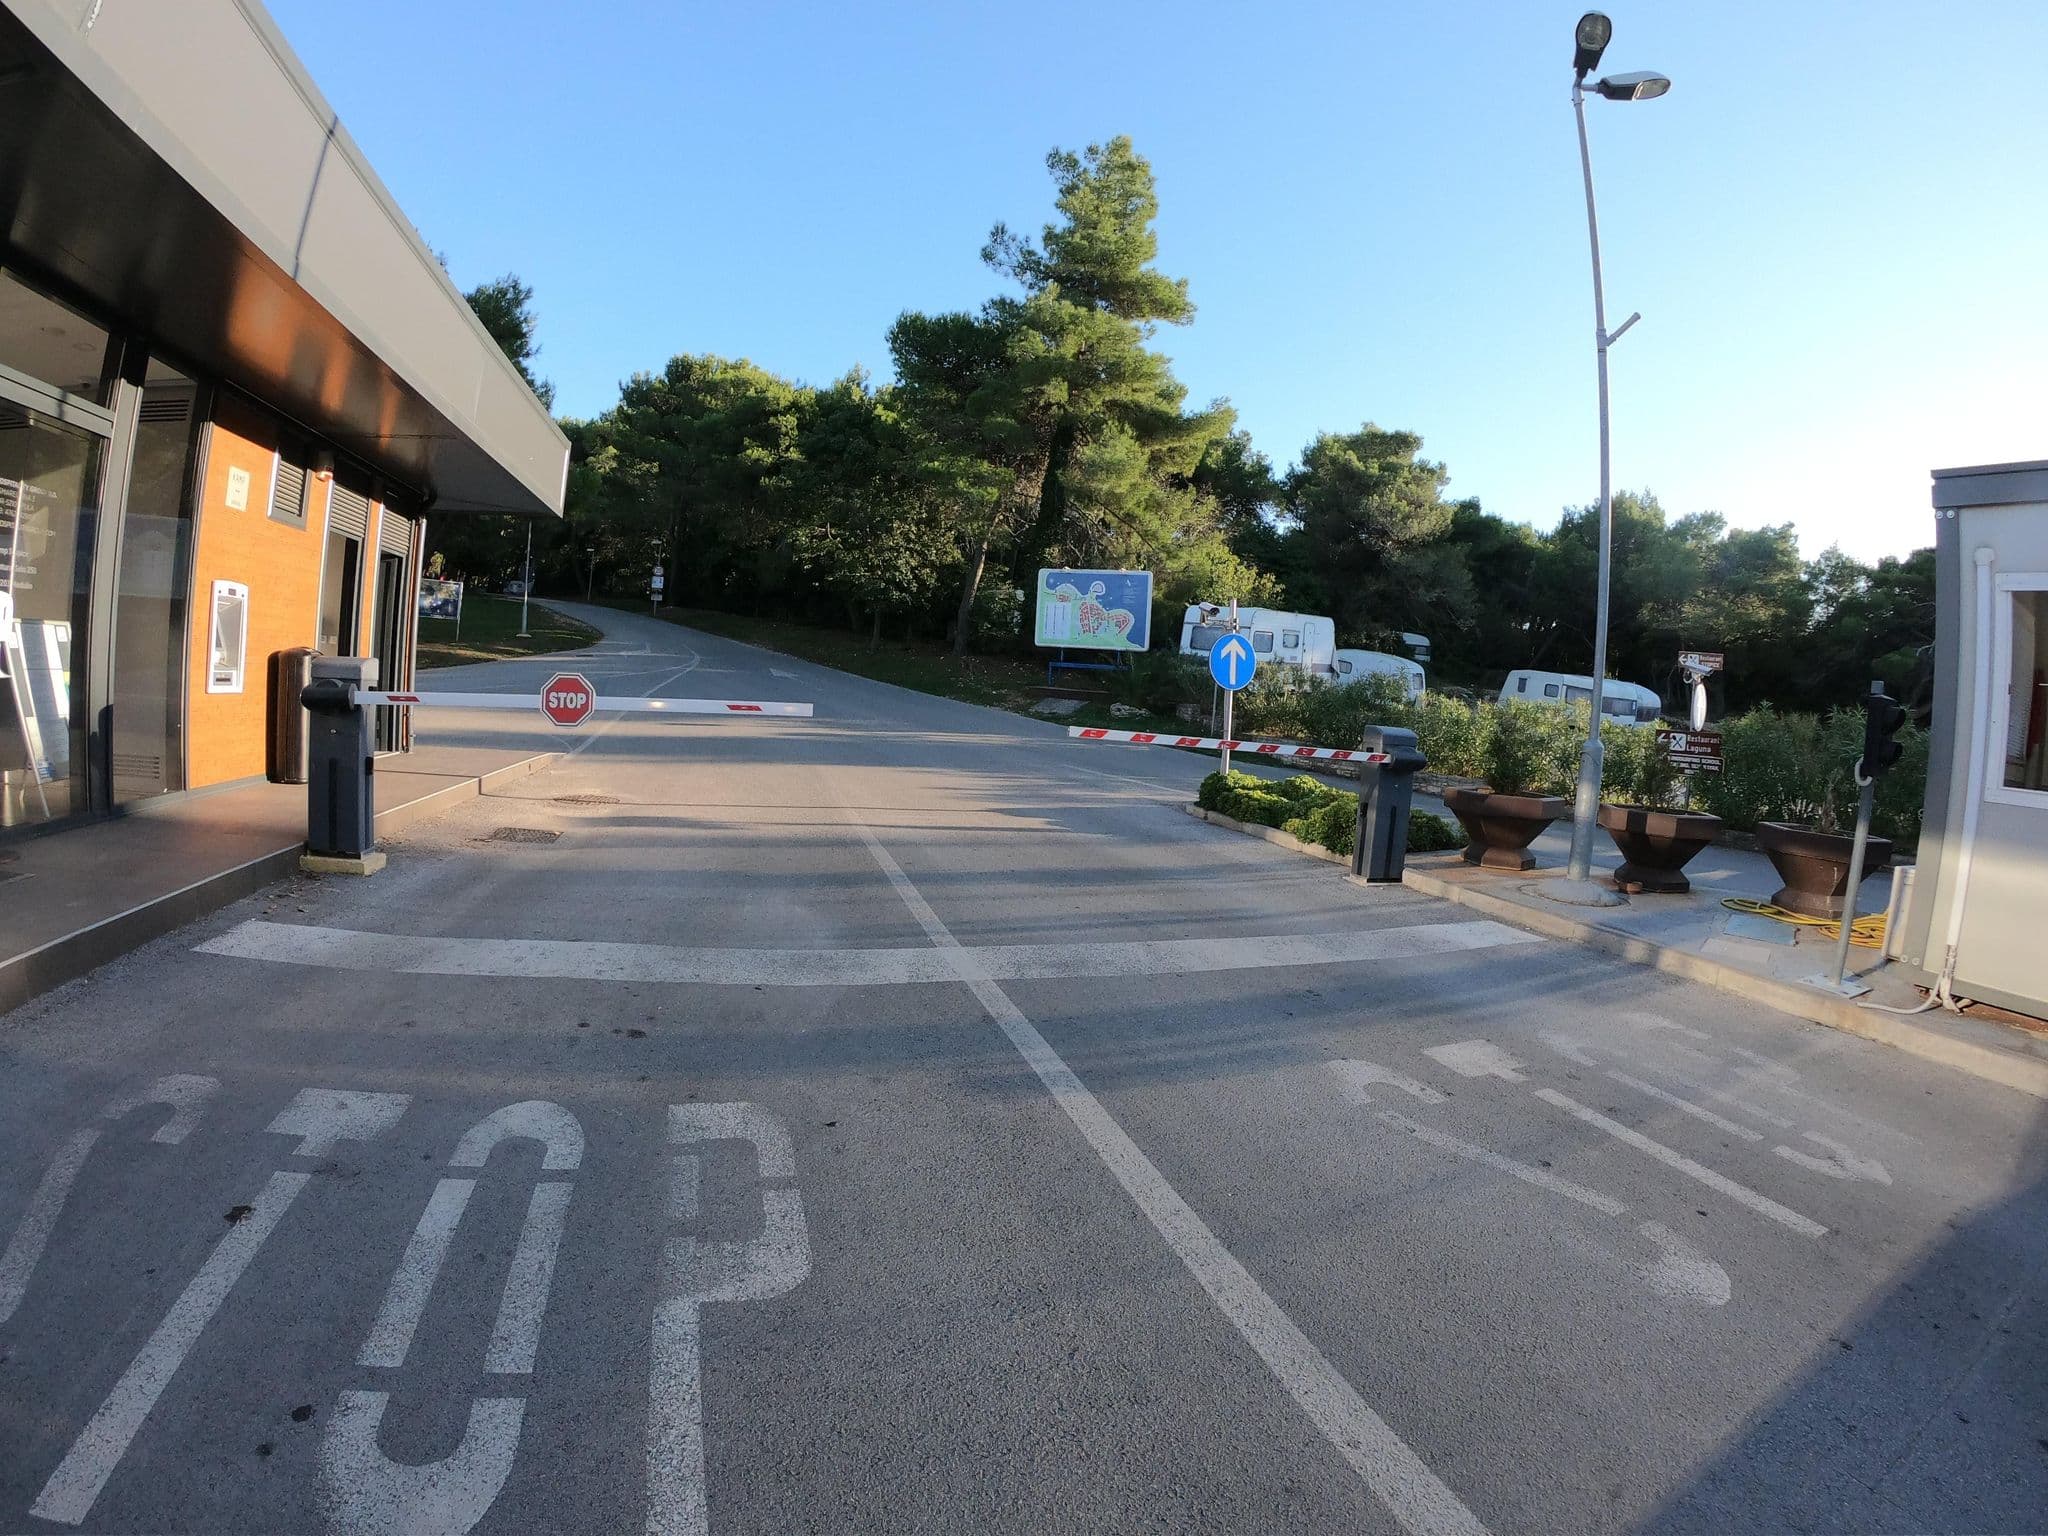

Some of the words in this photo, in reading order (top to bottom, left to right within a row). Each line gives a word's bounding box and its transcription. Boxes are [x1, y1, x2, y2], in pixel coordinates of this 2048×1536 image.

[549, 692, 587, 709] STOP
[1687, 735, 1720, 744] Restaurant
[1686, 744, 1712, 754] Laguna
